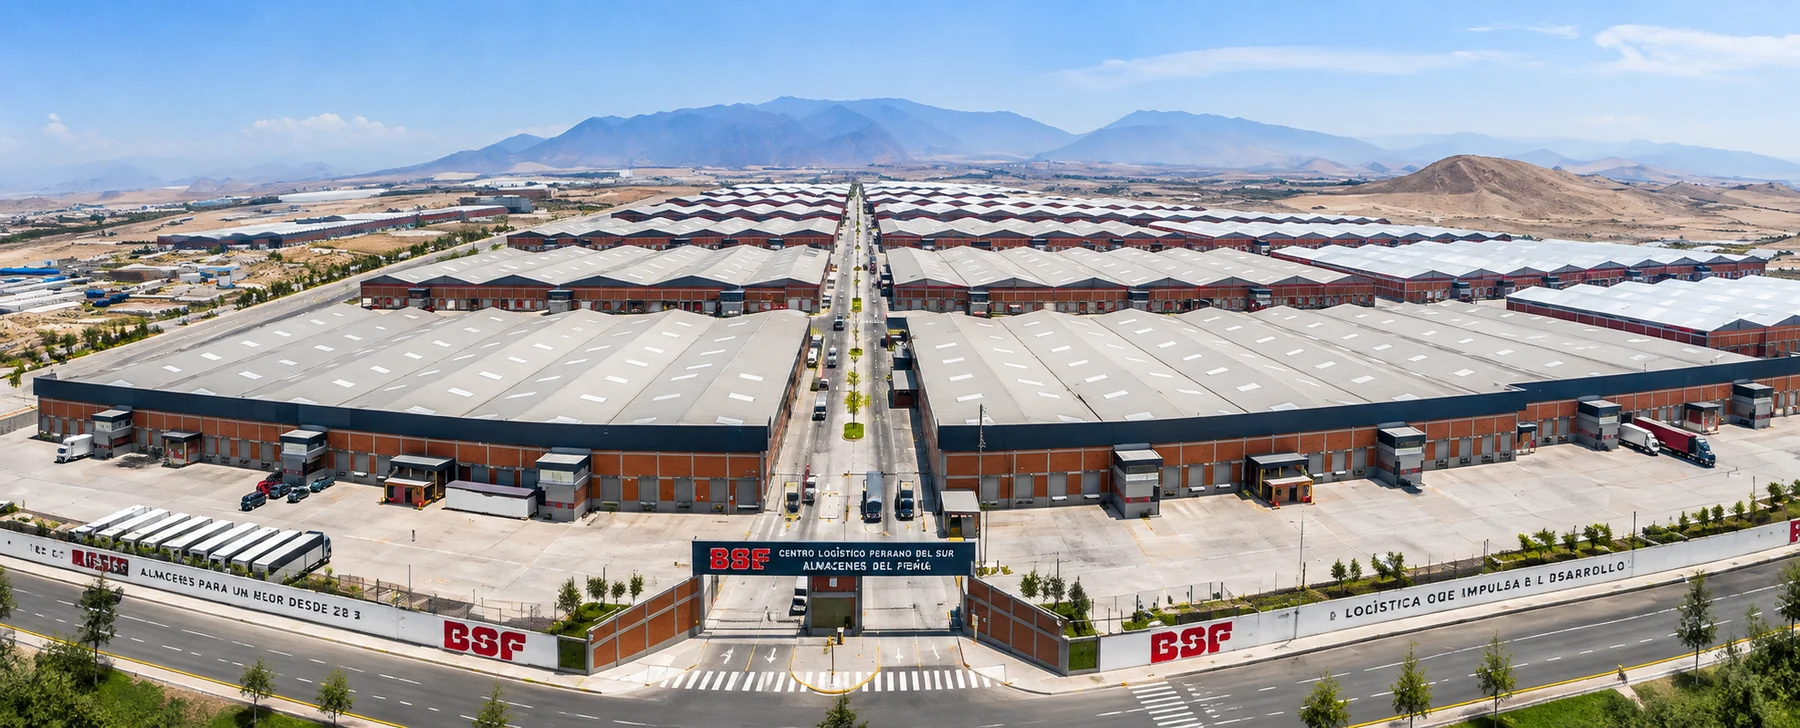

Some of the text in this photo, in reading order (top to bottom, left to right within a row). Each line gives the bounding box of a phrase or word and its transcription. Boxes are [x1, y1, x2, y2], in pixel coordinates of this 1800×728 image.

[709, 547, 771, 570] BSF
[778, 549, 815, 558] CENTRO
[915, 549, 933, 558] DEL
[935, 549, 955, 558] SUR
[872, 561, 893, 571] DEL
[198, 579, 228, 594] PARA
[288, 597, 328, 614] DESDE
[443, 619, 527, 661] BSF
[1150, 620, 1233, 664] BSF
